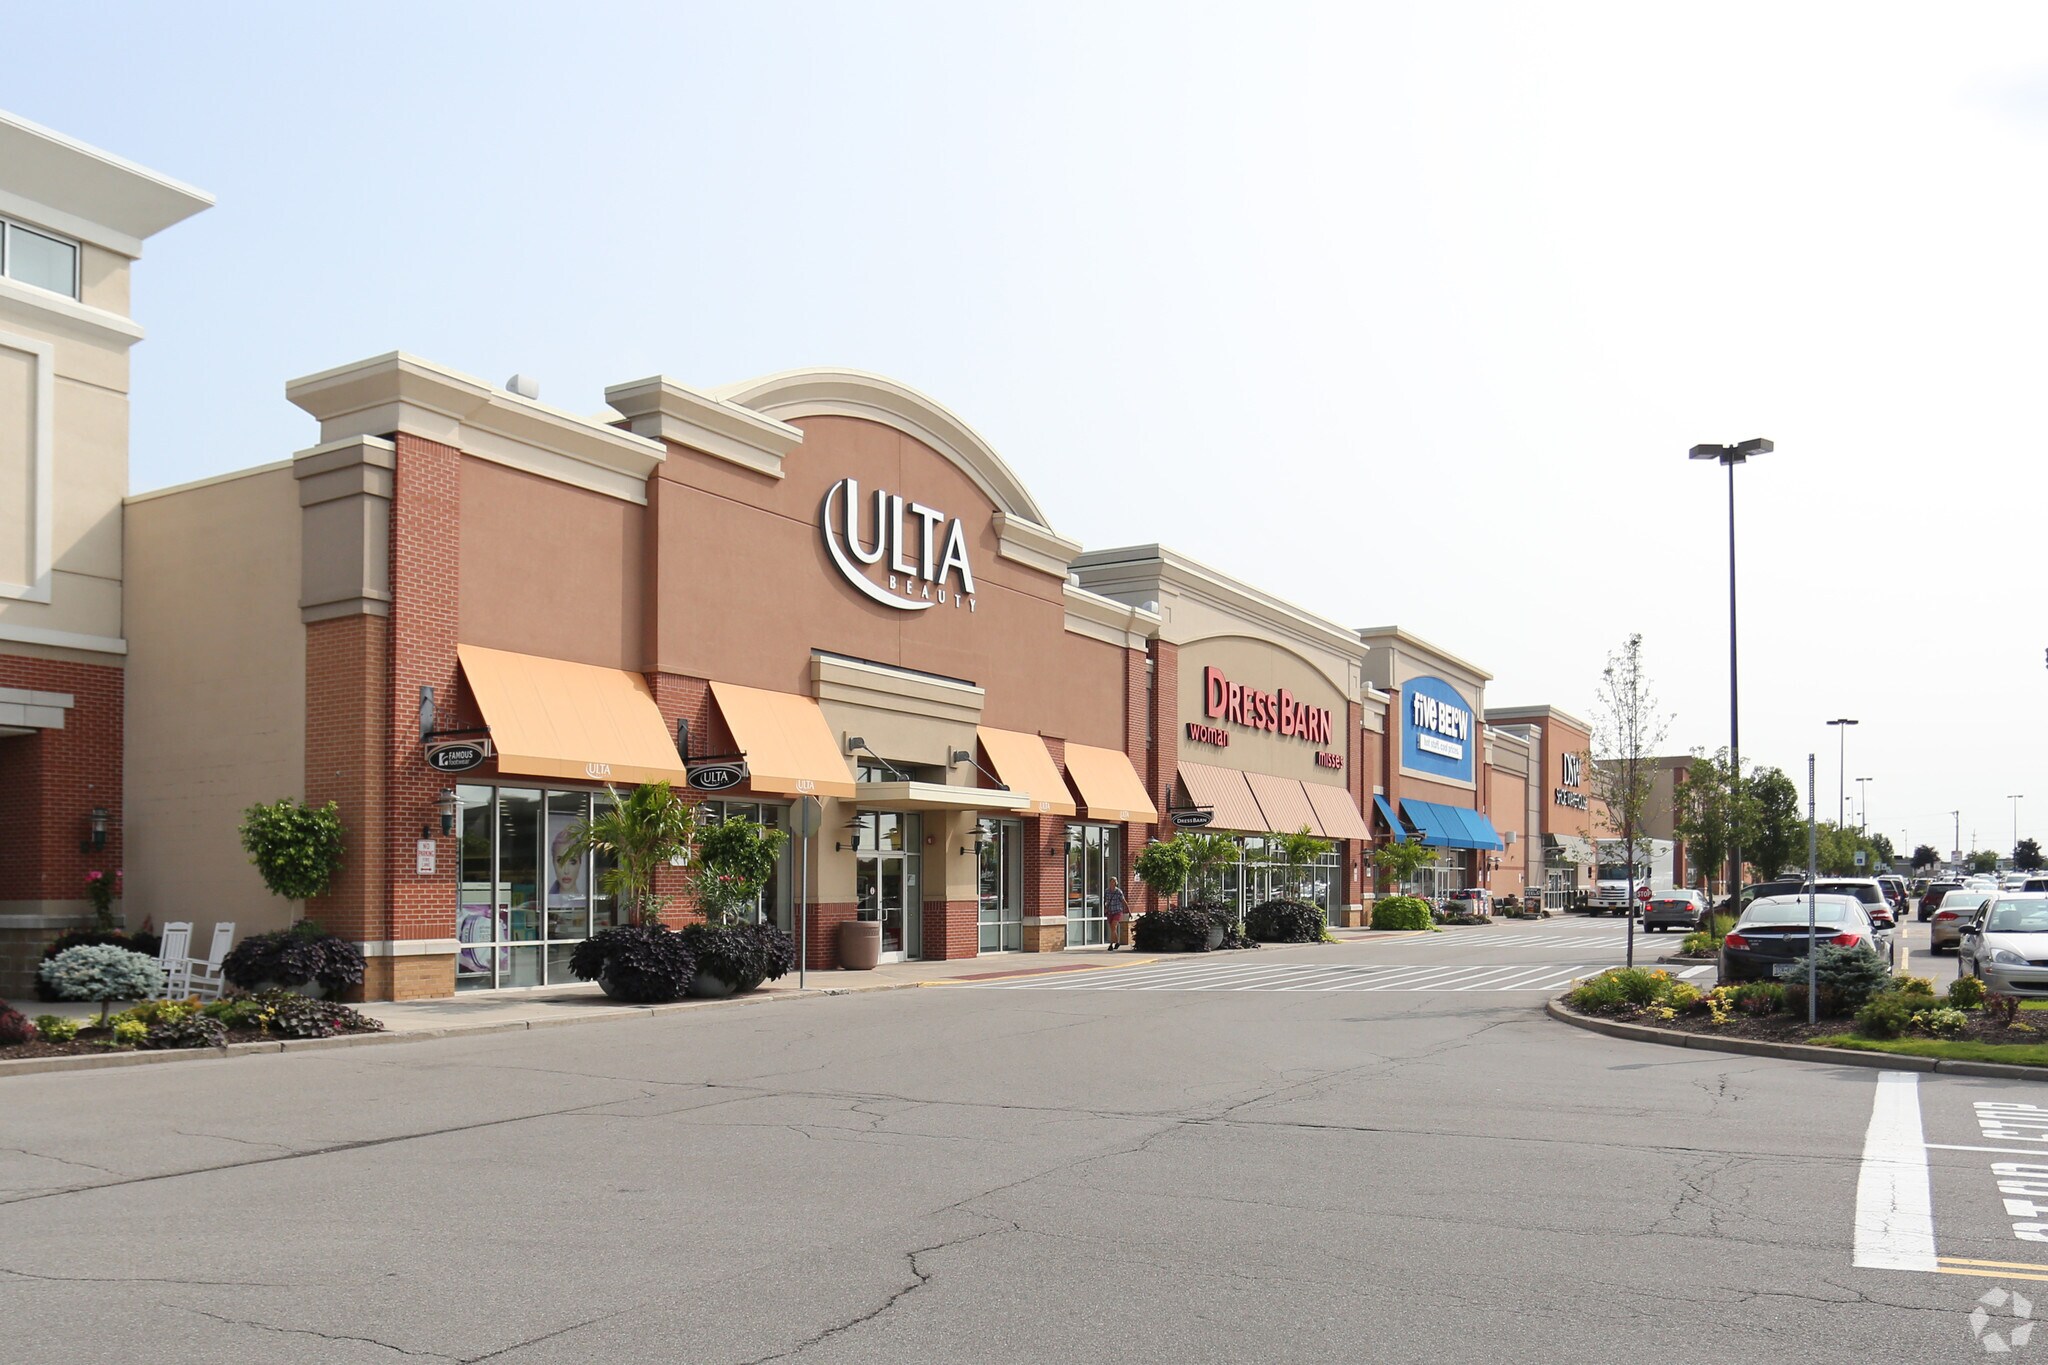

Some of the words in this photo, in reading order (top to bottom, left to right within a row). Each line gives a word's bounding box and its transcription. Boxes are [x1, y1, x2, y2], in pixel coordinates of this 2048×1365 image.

[842, 478, 975, 594] ULTA
[889, 575, 976, 612] BEAUTY
[1413, 691, 1438, 731] five
[1186, 722, 1230, 748] woman
[448, 751, 473, 760] FAMOUS
[1315, 751, 1343, 769] misses
[588, 761, 611, 776] ULTA
[703, 770, 729, 783] ULTA
[1562, 753, 1581, 787] DSW
[798, 779, 815, 791] ULTA
[1555, 787, 1568, 806] SHOE
[1636, 890, 1652, 898] STOP
